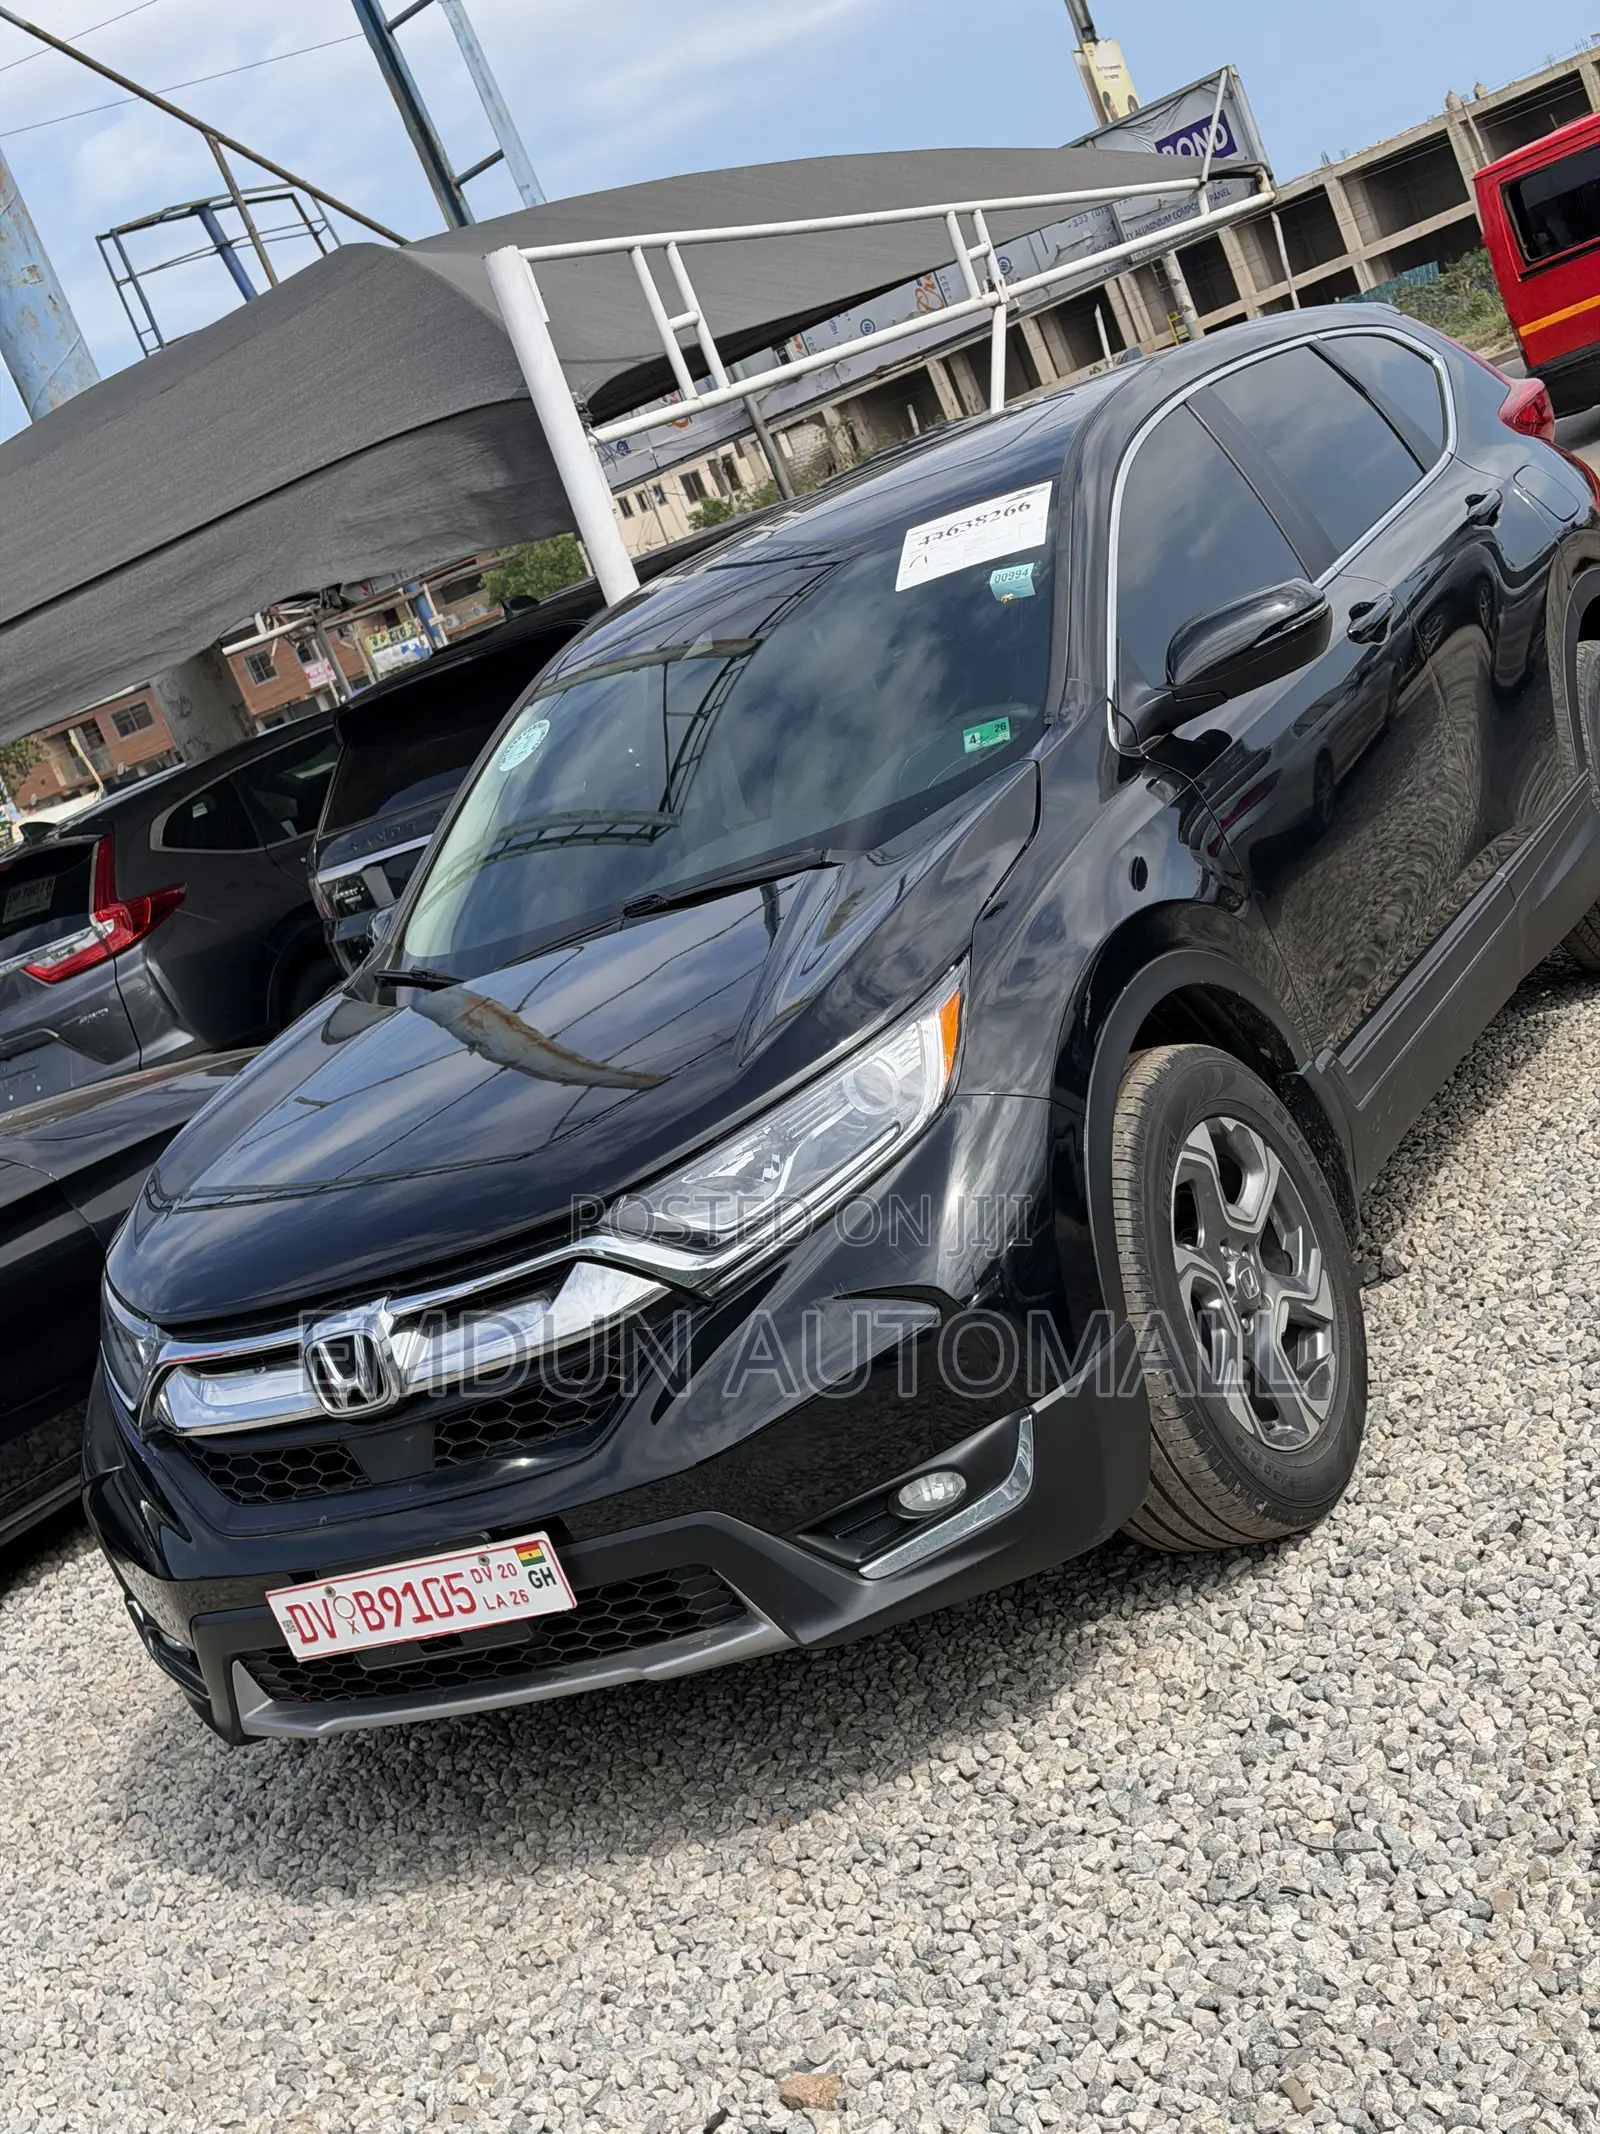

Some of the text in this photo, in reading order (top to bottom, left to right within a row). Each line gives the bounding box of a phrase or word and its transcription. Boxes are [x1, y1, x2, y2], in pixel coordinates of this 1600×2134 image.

[1134, 213, 1173, 238] ALUMINIUM
[1172, 203, 1200, 222] COMPOS
[1208, 188, 1232, 203] PANEL
[994, 568, 1029, 584] 00994
[969, 734, 977, 744] 4
[994, 722, 1007, 733] 26
[470, 1562, 518, 1585] DV 20
[527, 1566, 558, 1590] GH
[285, 1598, 337, 1645] DV
[352, 1572, 478, 1632] B9105
[482, 1588, 530, 1611] LA 26
